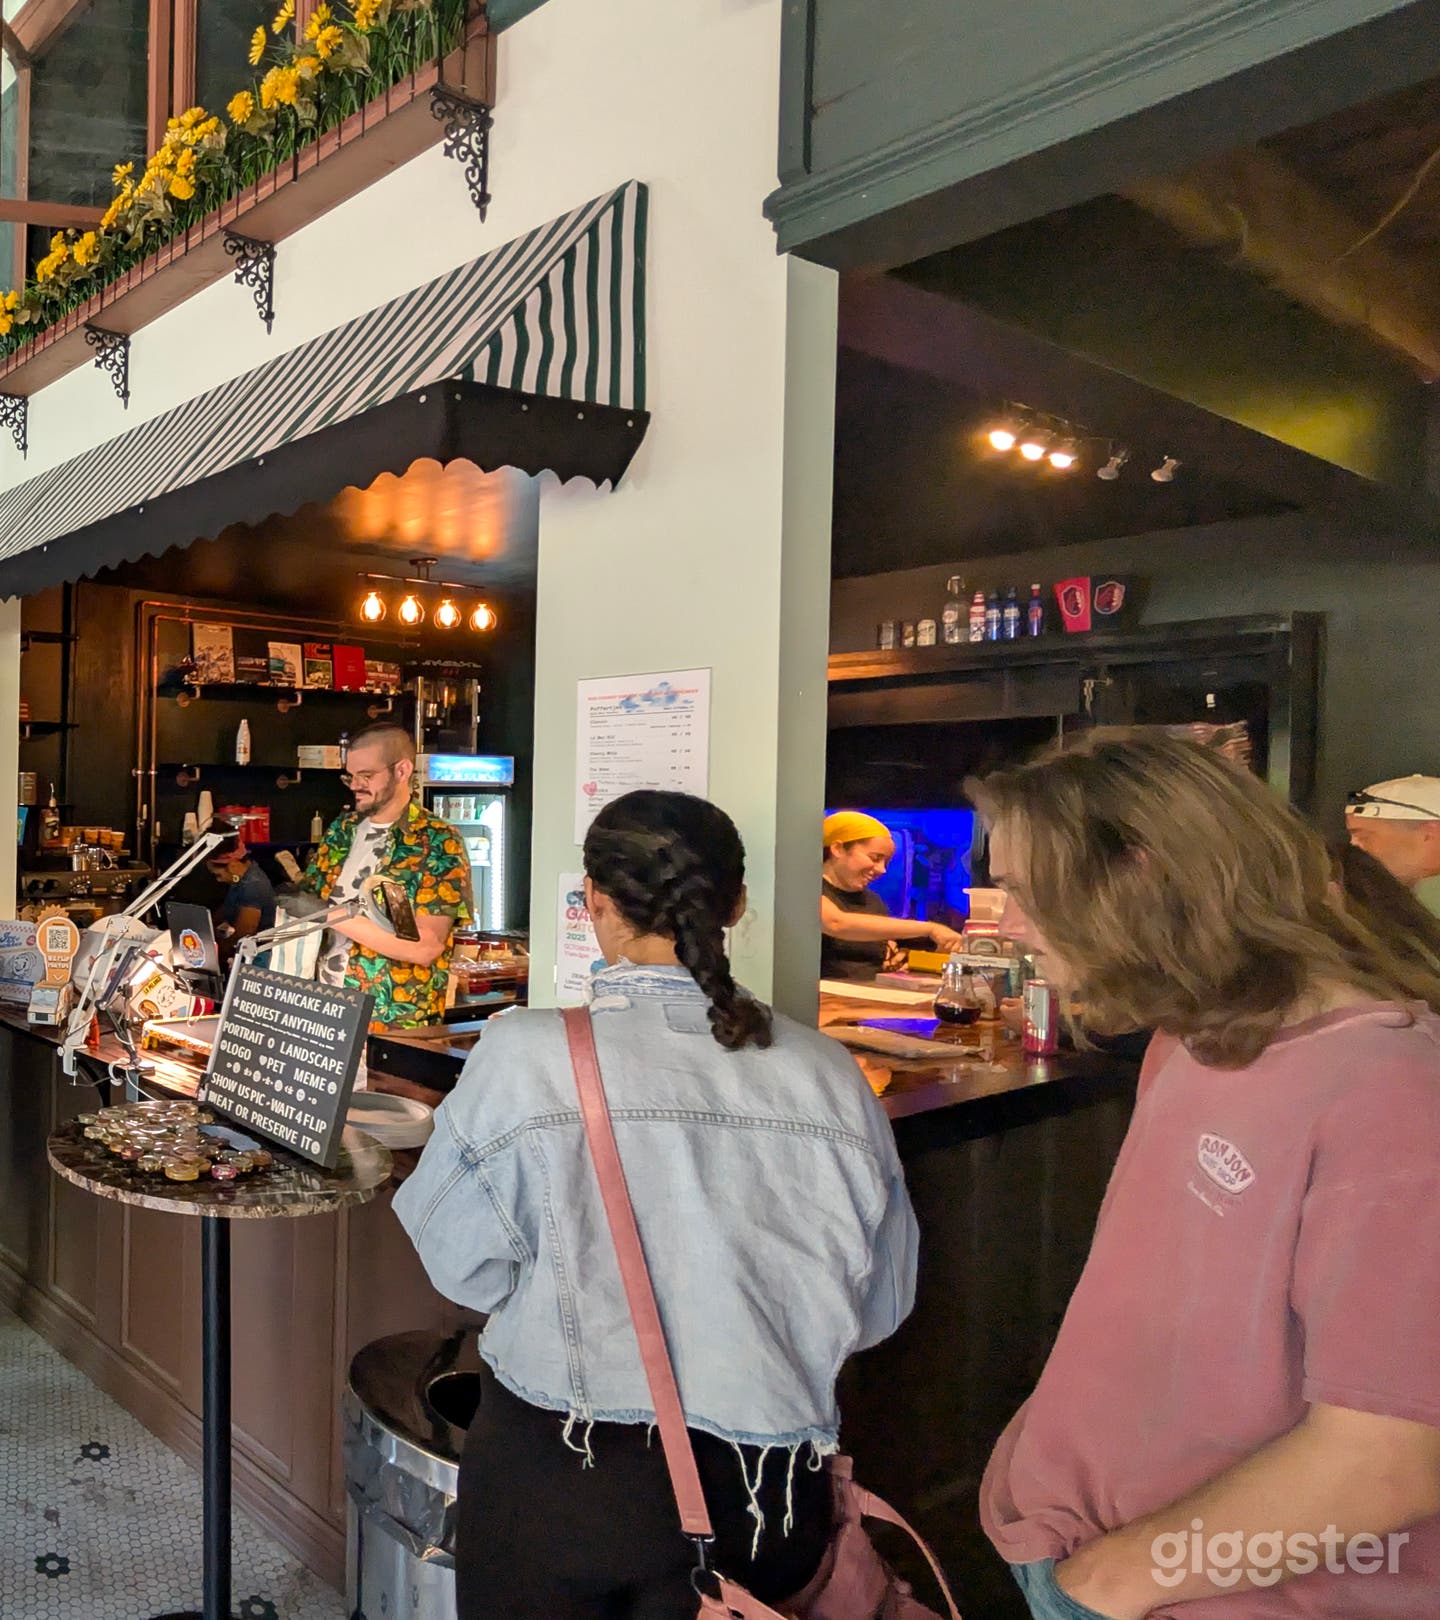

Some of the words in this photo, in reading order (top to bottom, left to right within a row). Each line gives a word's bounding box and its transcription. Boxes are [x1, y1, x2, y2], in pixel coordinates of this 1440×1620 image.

[239, 1000, 281, 1023] REQUEST
[280, 1013, 336, 1041] ANYTHING
[242, 979, 262, 995] THIS
[263, 985, 273, 998] IS
[274, 988, 322, 1012] PANCAKE
[322, 1002, 346, 1019] ART
[222, 1020, 265, 1045] PORTRAIT
[279, 1041, 344, 1075] LANDSCAPE
[226, 1042, 251, 1060] LOGO
[266, 1057, 287, 1075] PET
[293, 1067, 327, 1092] MEME
[211, 1072, 238, 1093] SHOW
[237, 1083, 251, 1099] US
[250, 1089, 266, 1106] PIC
[270, 1097, 297, 1120] WAIT
[295, 1110, 303, 1124] 4
[302, 1113, 327, 1134] FLIP
[235, 1103, 249, 1120] OR
[250, 1110, 298, 1145] PRESERVE
[300, 1135, 313, 1151] IT
[1200, 1137, 1229, 1158] RON
[1224, 1153, 1251, 1182] JON
